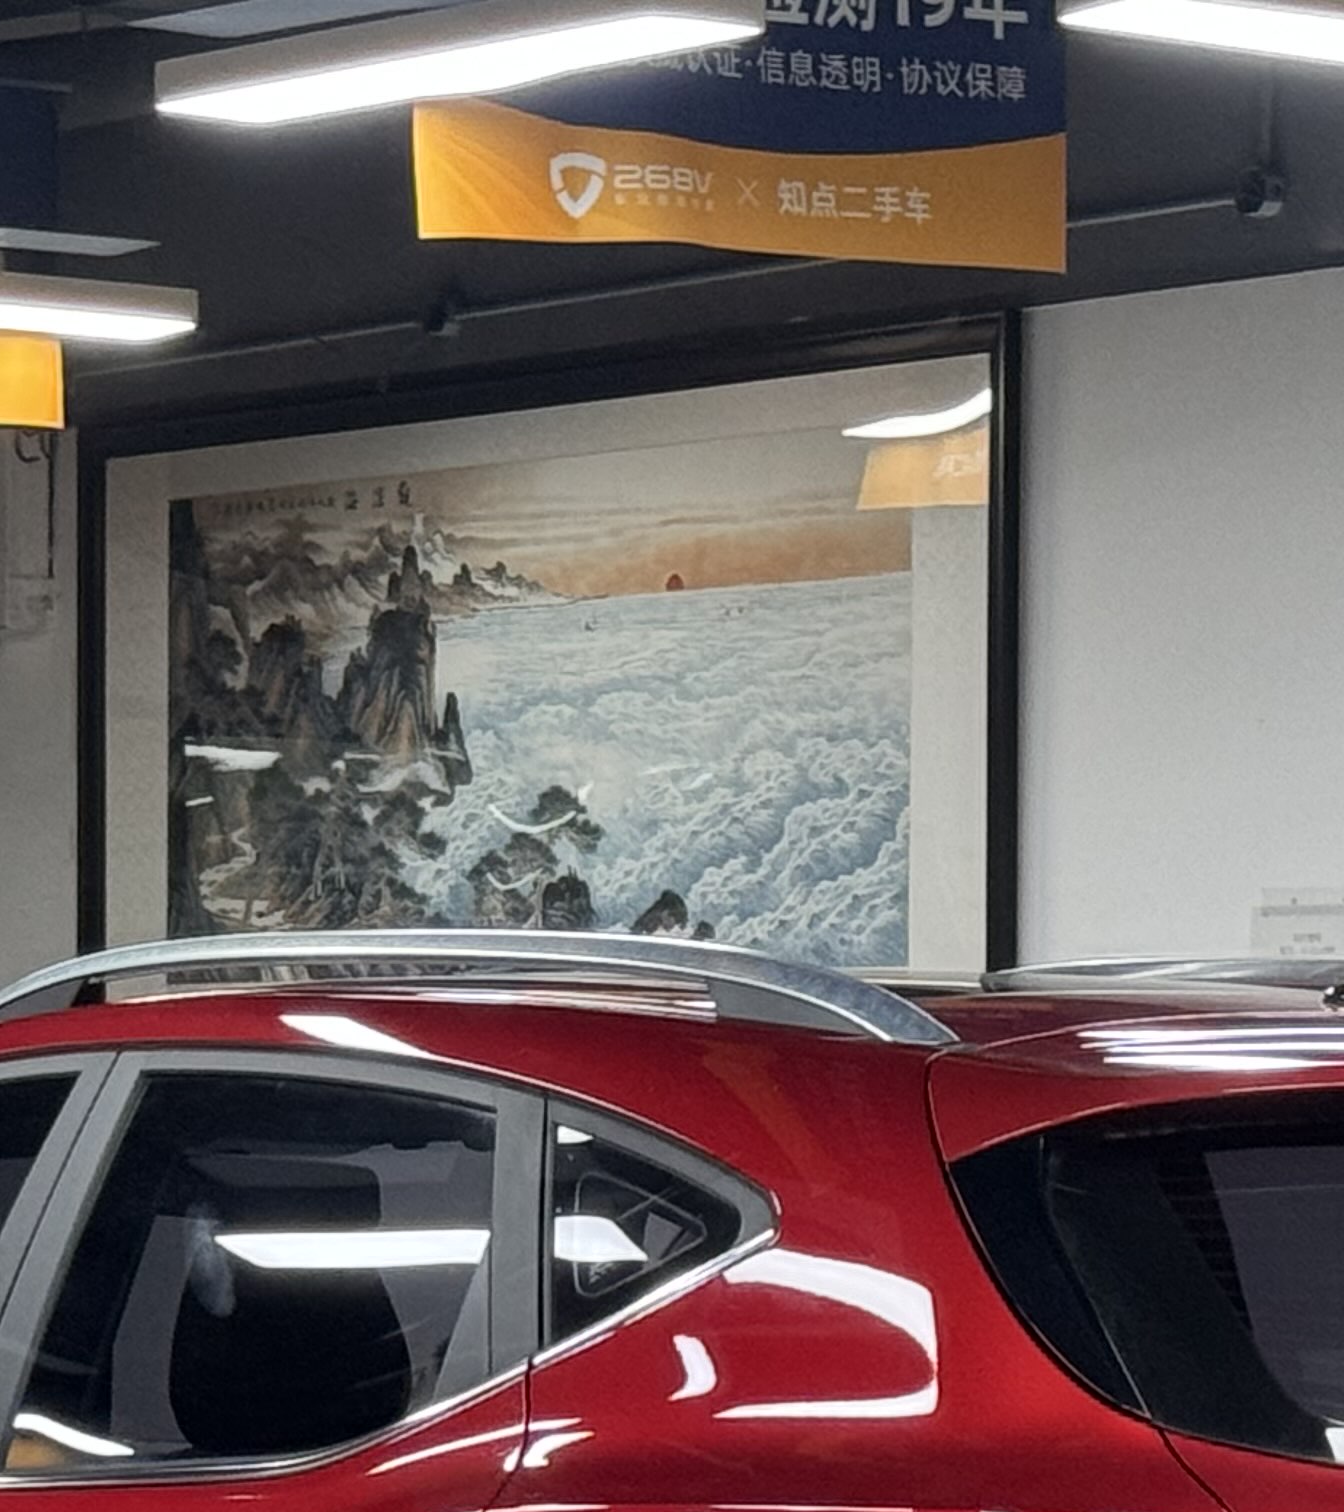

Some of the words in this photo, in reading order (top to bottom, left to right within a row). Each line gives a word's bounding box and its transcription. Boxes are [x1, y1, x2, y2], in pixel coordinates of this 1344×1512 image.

[613, 164, 714, 195] 268V
[776, 178, 934, 226] 知点二手车
